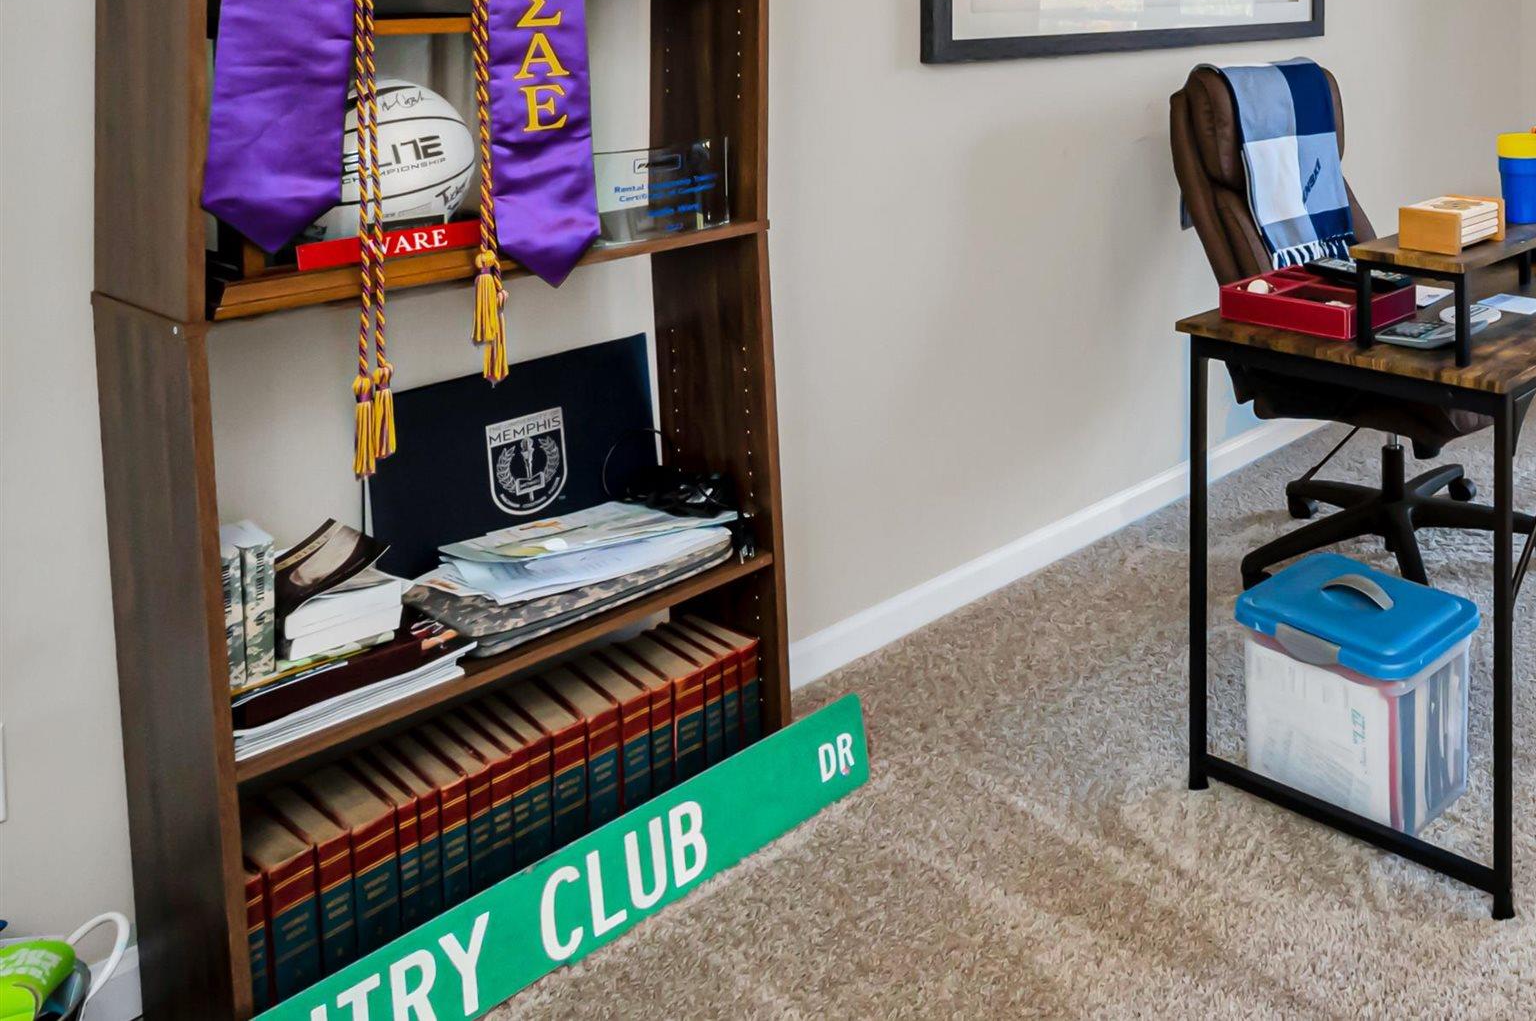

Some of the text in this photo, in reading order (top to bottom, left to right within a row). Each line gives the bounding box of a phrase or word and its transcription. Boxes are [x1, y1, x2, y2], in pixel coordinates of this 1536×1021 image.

[488, 415, 561, 446] MEMPHIS
[310, 910, 490, 1021] TRY
[539, 800, 709, 962] CLUB
[817, 731, 856, 784] DR
